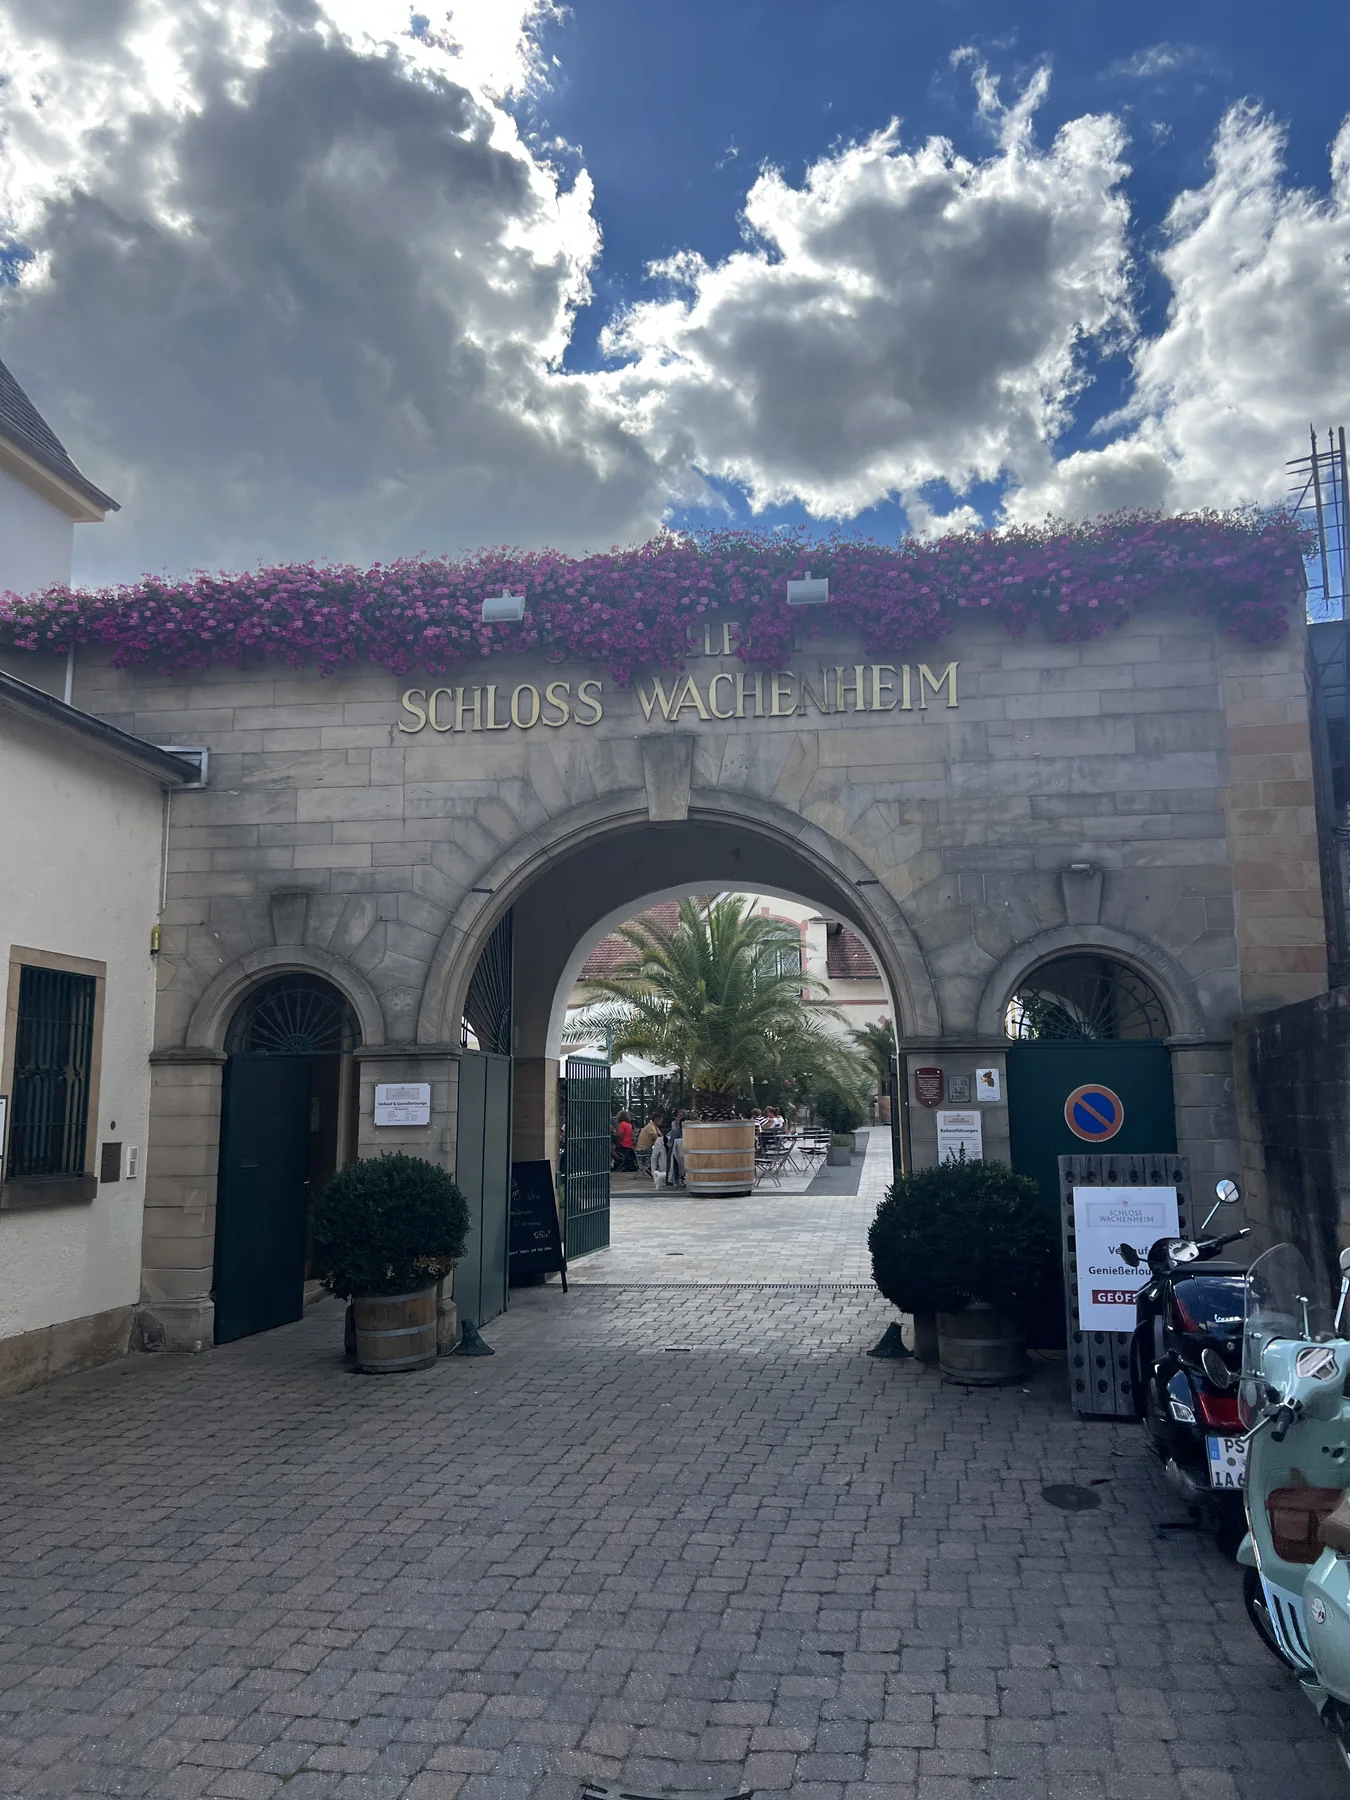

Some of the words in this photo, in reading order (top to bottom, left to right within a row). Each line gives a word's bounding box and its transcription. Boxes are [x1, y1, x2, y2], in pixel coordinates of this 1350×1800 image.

[398, 680, 604, 734] SCHLOSS
[634, 661, 960, 721] WACHENHEIM
[1224, 1438, 1245, 1454] PS
